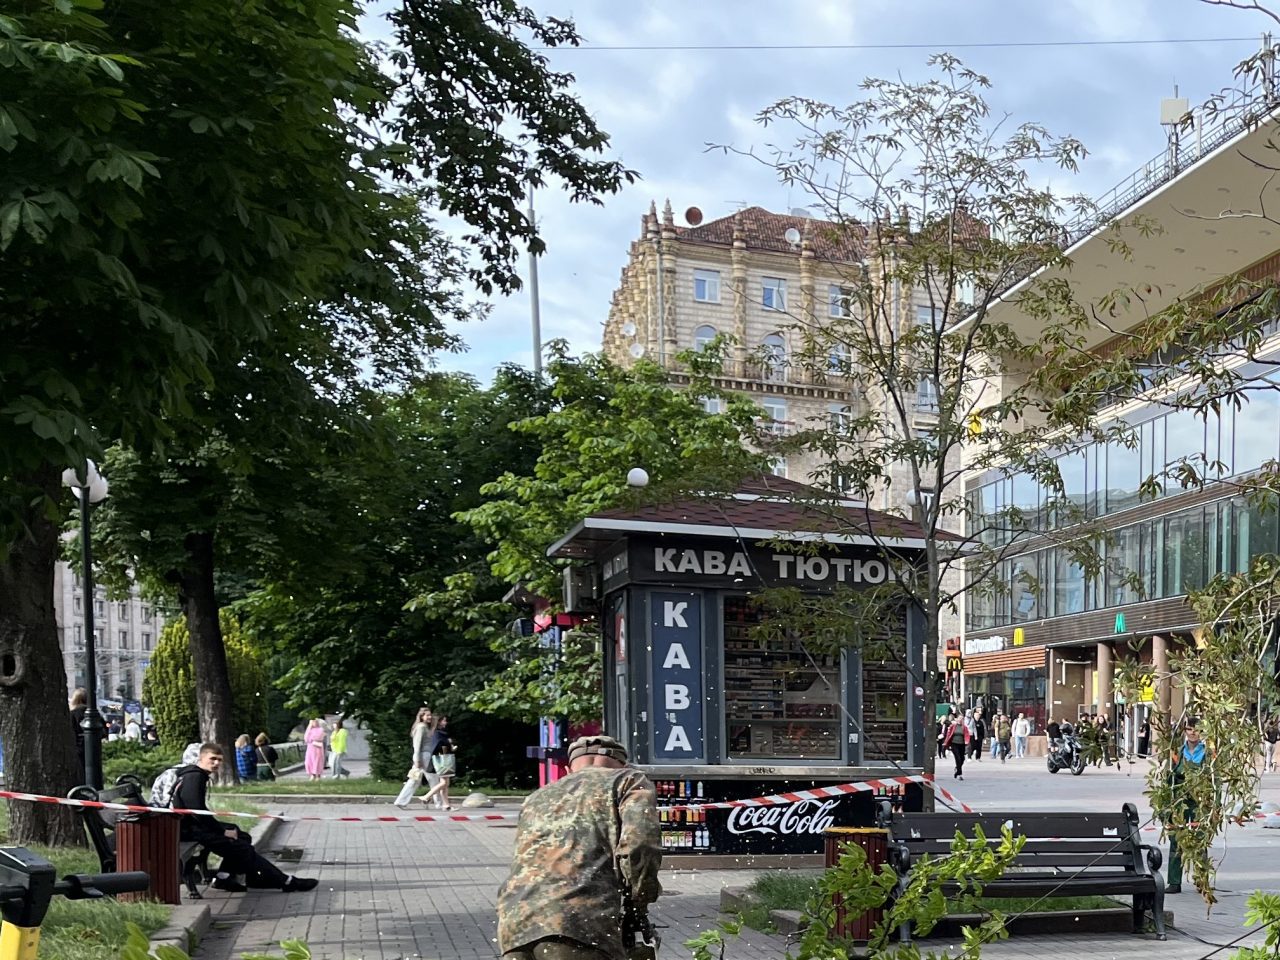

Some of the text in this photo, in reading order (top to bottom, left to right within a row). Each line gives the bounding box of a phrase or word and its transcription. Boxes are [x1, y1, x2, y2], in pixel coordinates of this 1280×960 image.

[655, 548, 752, 576] КАВА
[772, 554, 910, 584] ТЮТЮН
[662, 601, 693, 751] КАВА
[727, 799, 841, 834] Coca-Cola
